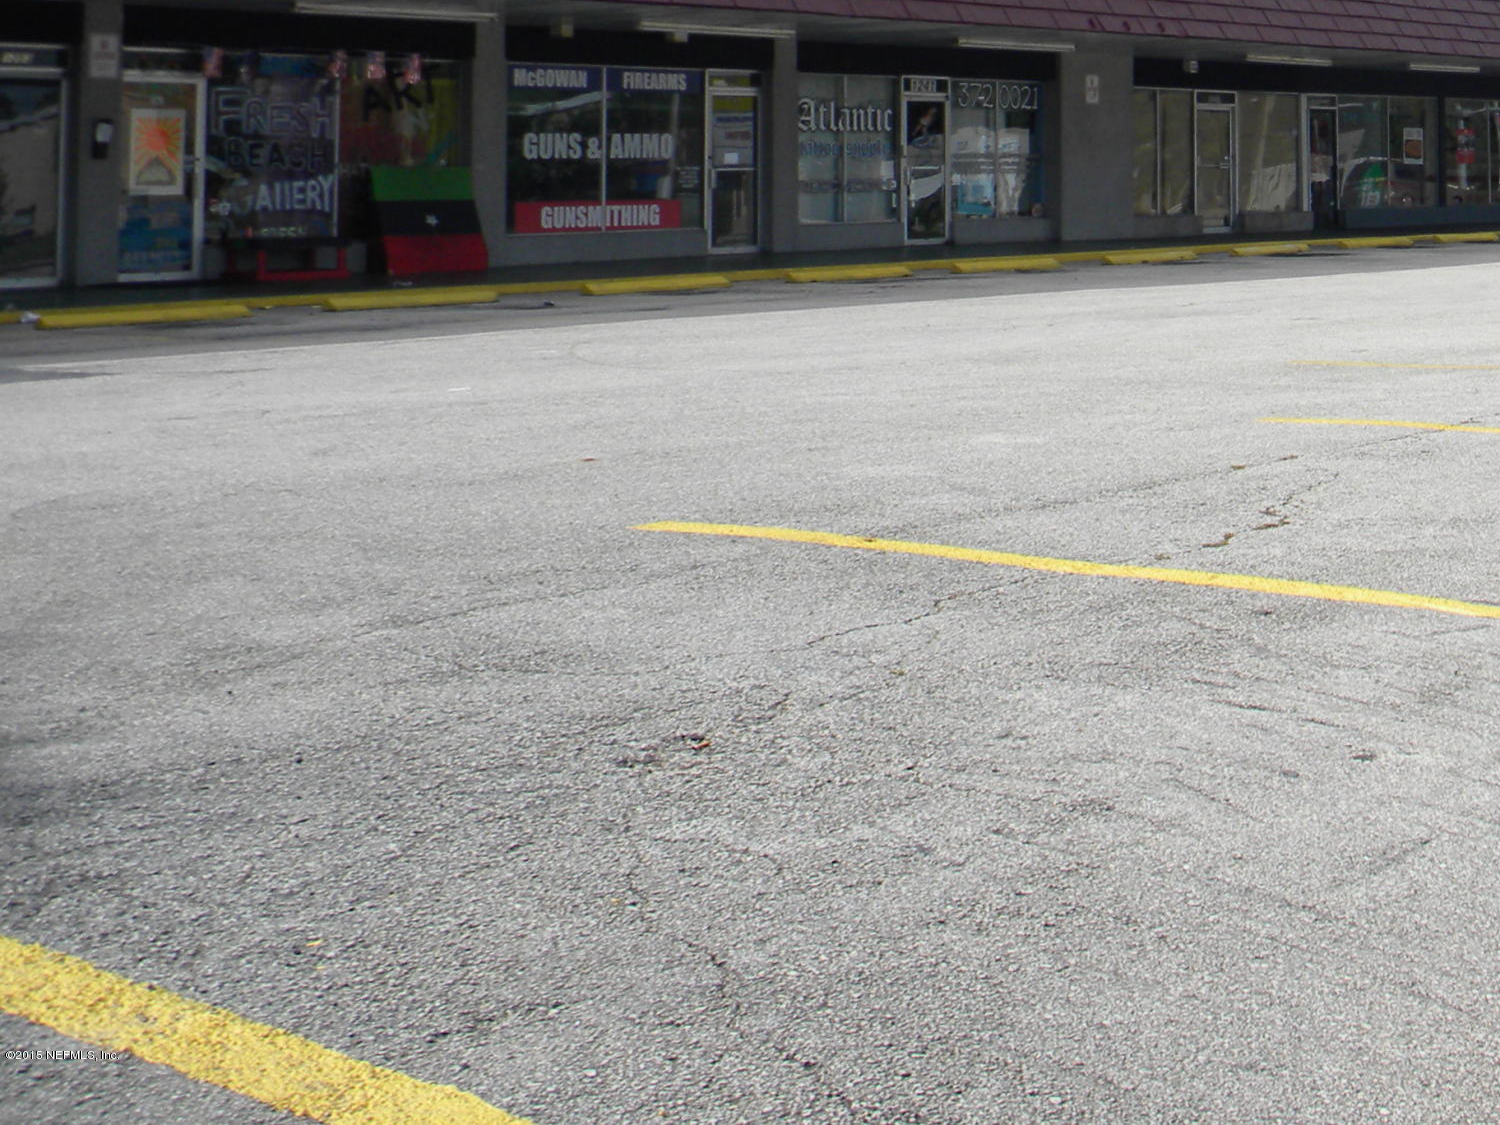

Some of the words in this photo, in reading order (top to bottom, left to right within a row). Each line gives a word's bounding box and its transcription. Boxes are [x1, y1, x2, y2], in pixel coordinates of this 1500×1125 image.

[513, 68, 588, 89] McGOWAN
[623, 72, 688, 91] FIREARMS
[999, 84, 1039, 110] 0021
[211, 86, 335, 139] FRESH
[797, 98, 894, 133] Atlantic
[523, 132, 582, 160] GUNS
[587, 137, 602, 159] &
[610, 133, 673, 159] AMMO
[540, 204, 661, 229] GUNSMITHING
